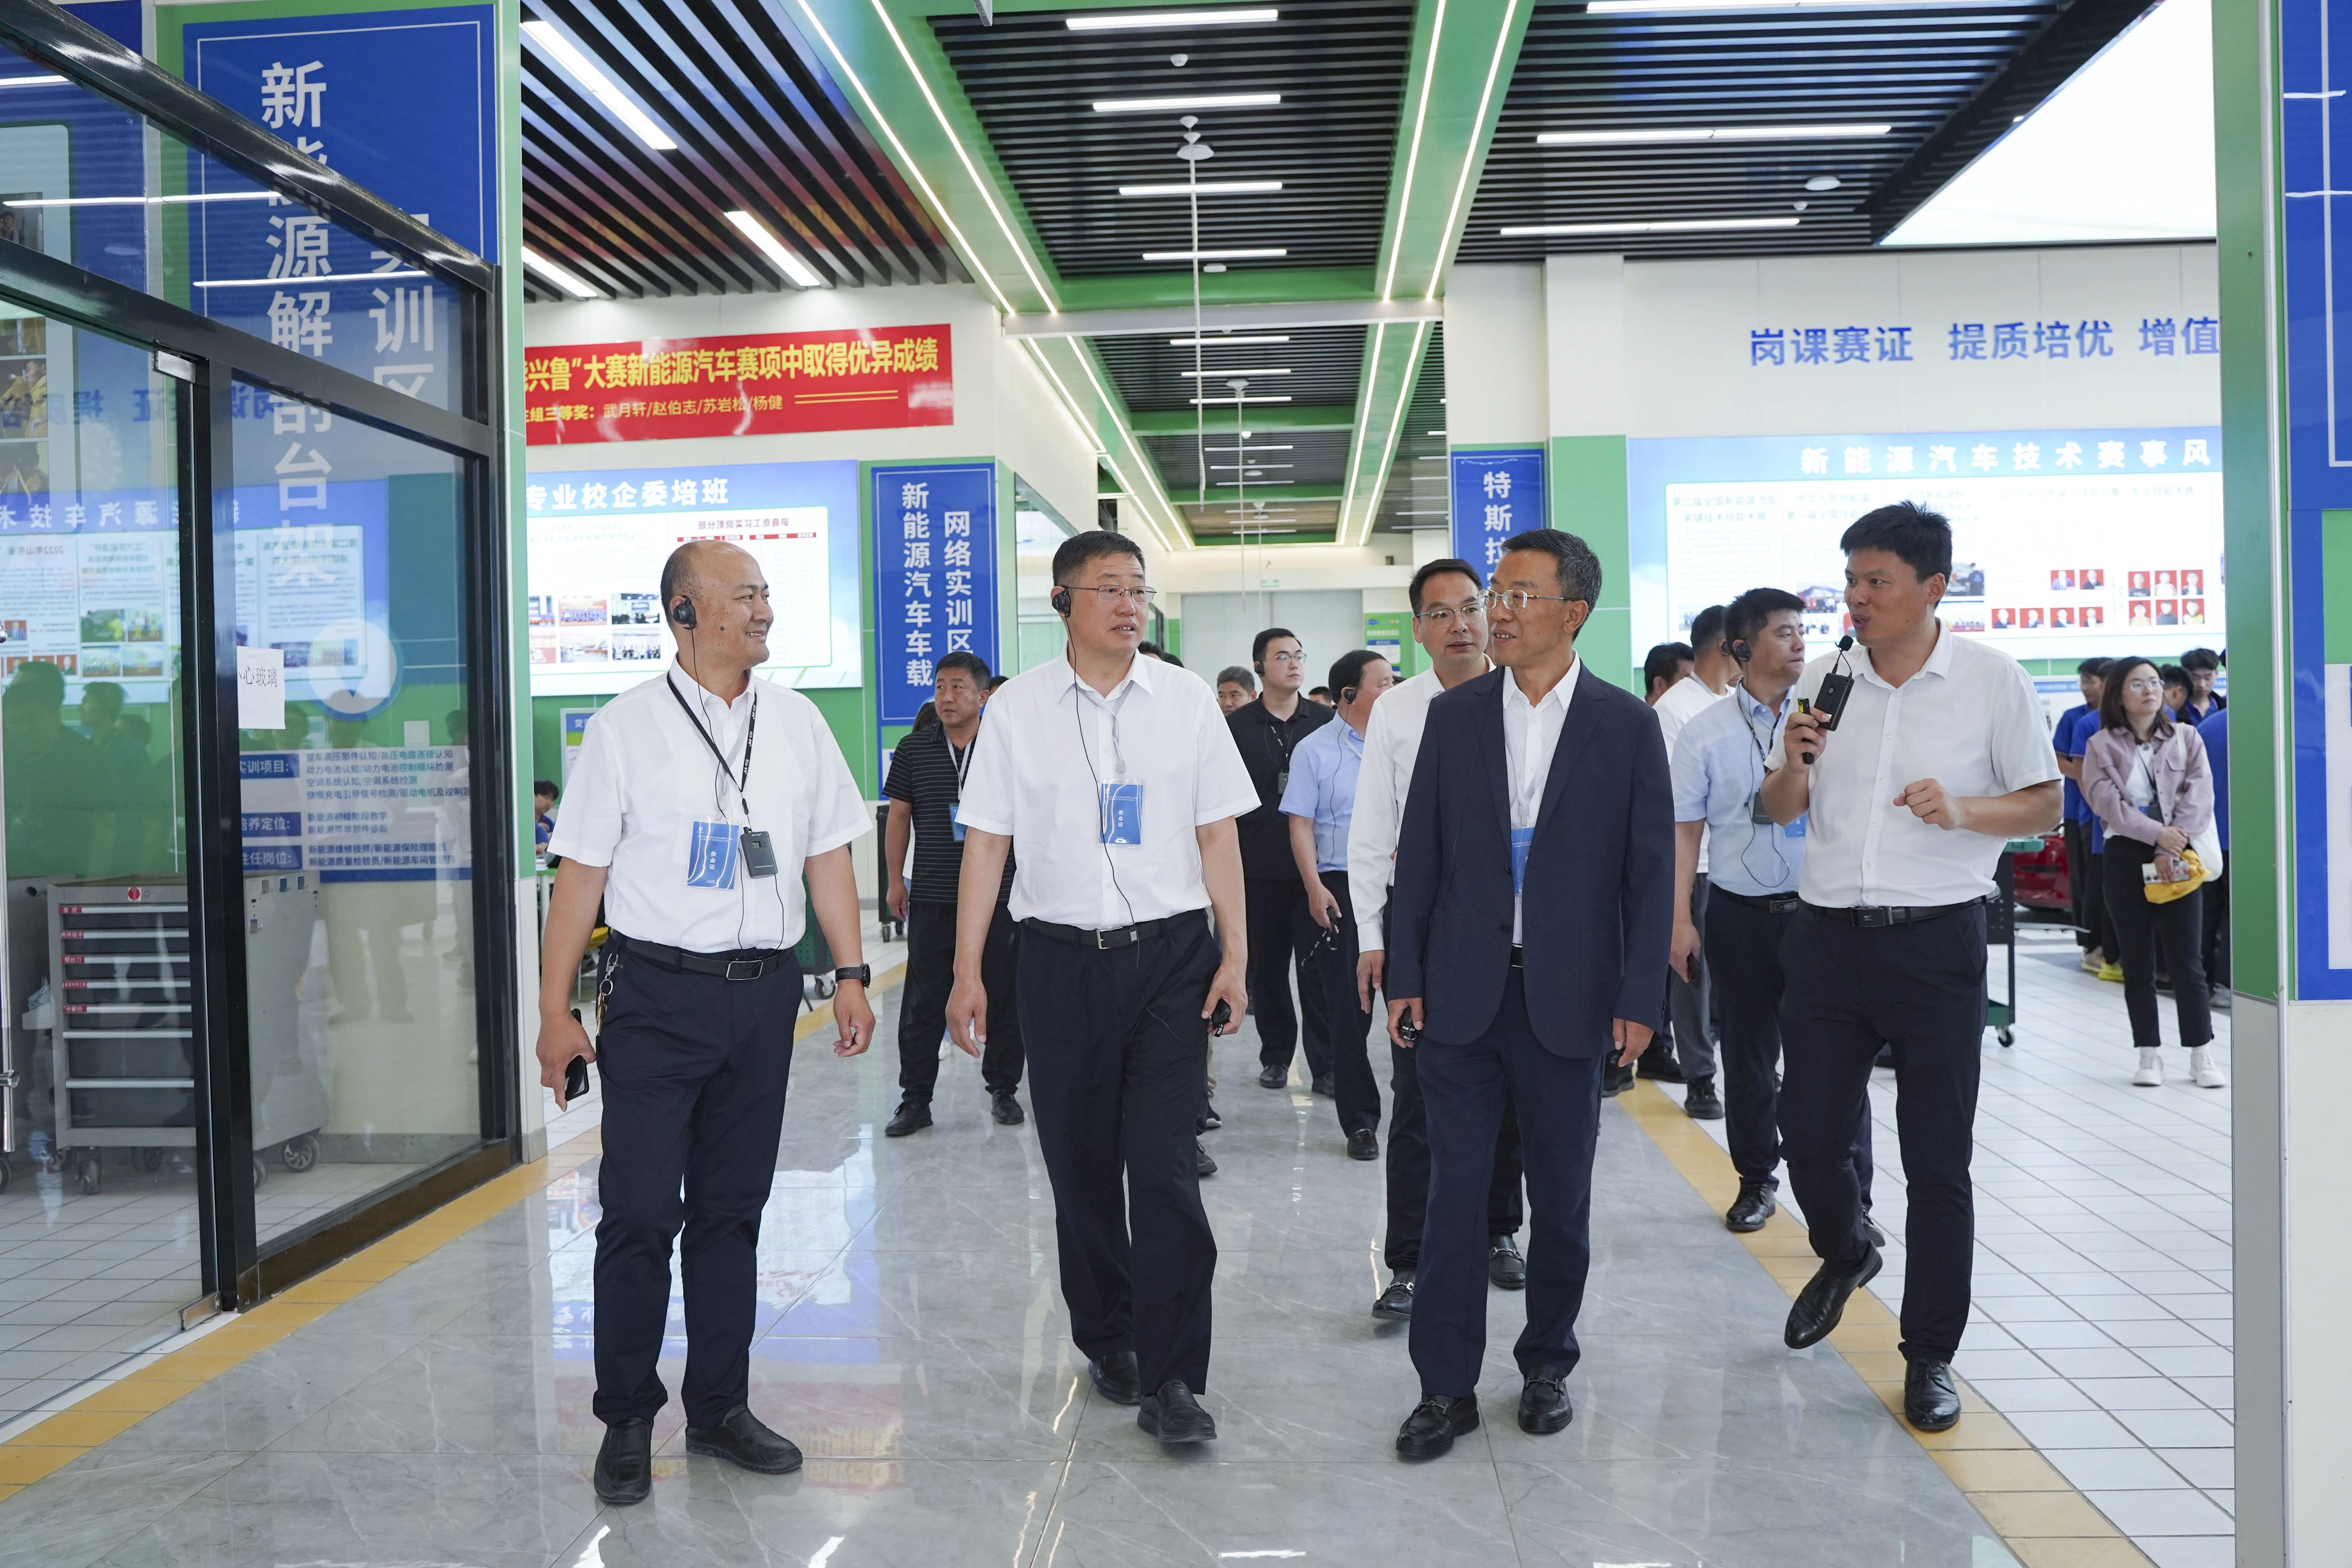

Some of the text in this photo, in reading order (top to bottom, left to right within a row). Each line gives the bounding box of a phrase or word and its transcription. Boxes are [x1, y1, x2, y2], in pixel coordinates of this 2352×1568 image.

[261, 61, 336, 587] 新源解剖台架
[369, 208, 436, 400] 训区
[525, 337, 938, 392] 兴鲁”大赛新能源汽车赛项中取得优异成绩
[1751, 316, 2219, 366] 岗课赛证 提质培优 增值
[603, 395, 783, 418] 武月轩/赵伯志/苏岩松/杨健
[1800, 439, 2212, 475] 新能源汽车技术赛事风
[526, 478, 728, 511] 专业校企委培班
[1483, 470, 1512, 590] 特斯拉
[902, 482, 933, 687] 新能源汽车车载
[944, 511, 973, 654] 网络实训区
[238, 665, 277, 688] 心玻璃
[309, 855, 455, 866] 新能源质量检验员/新能源车间管
